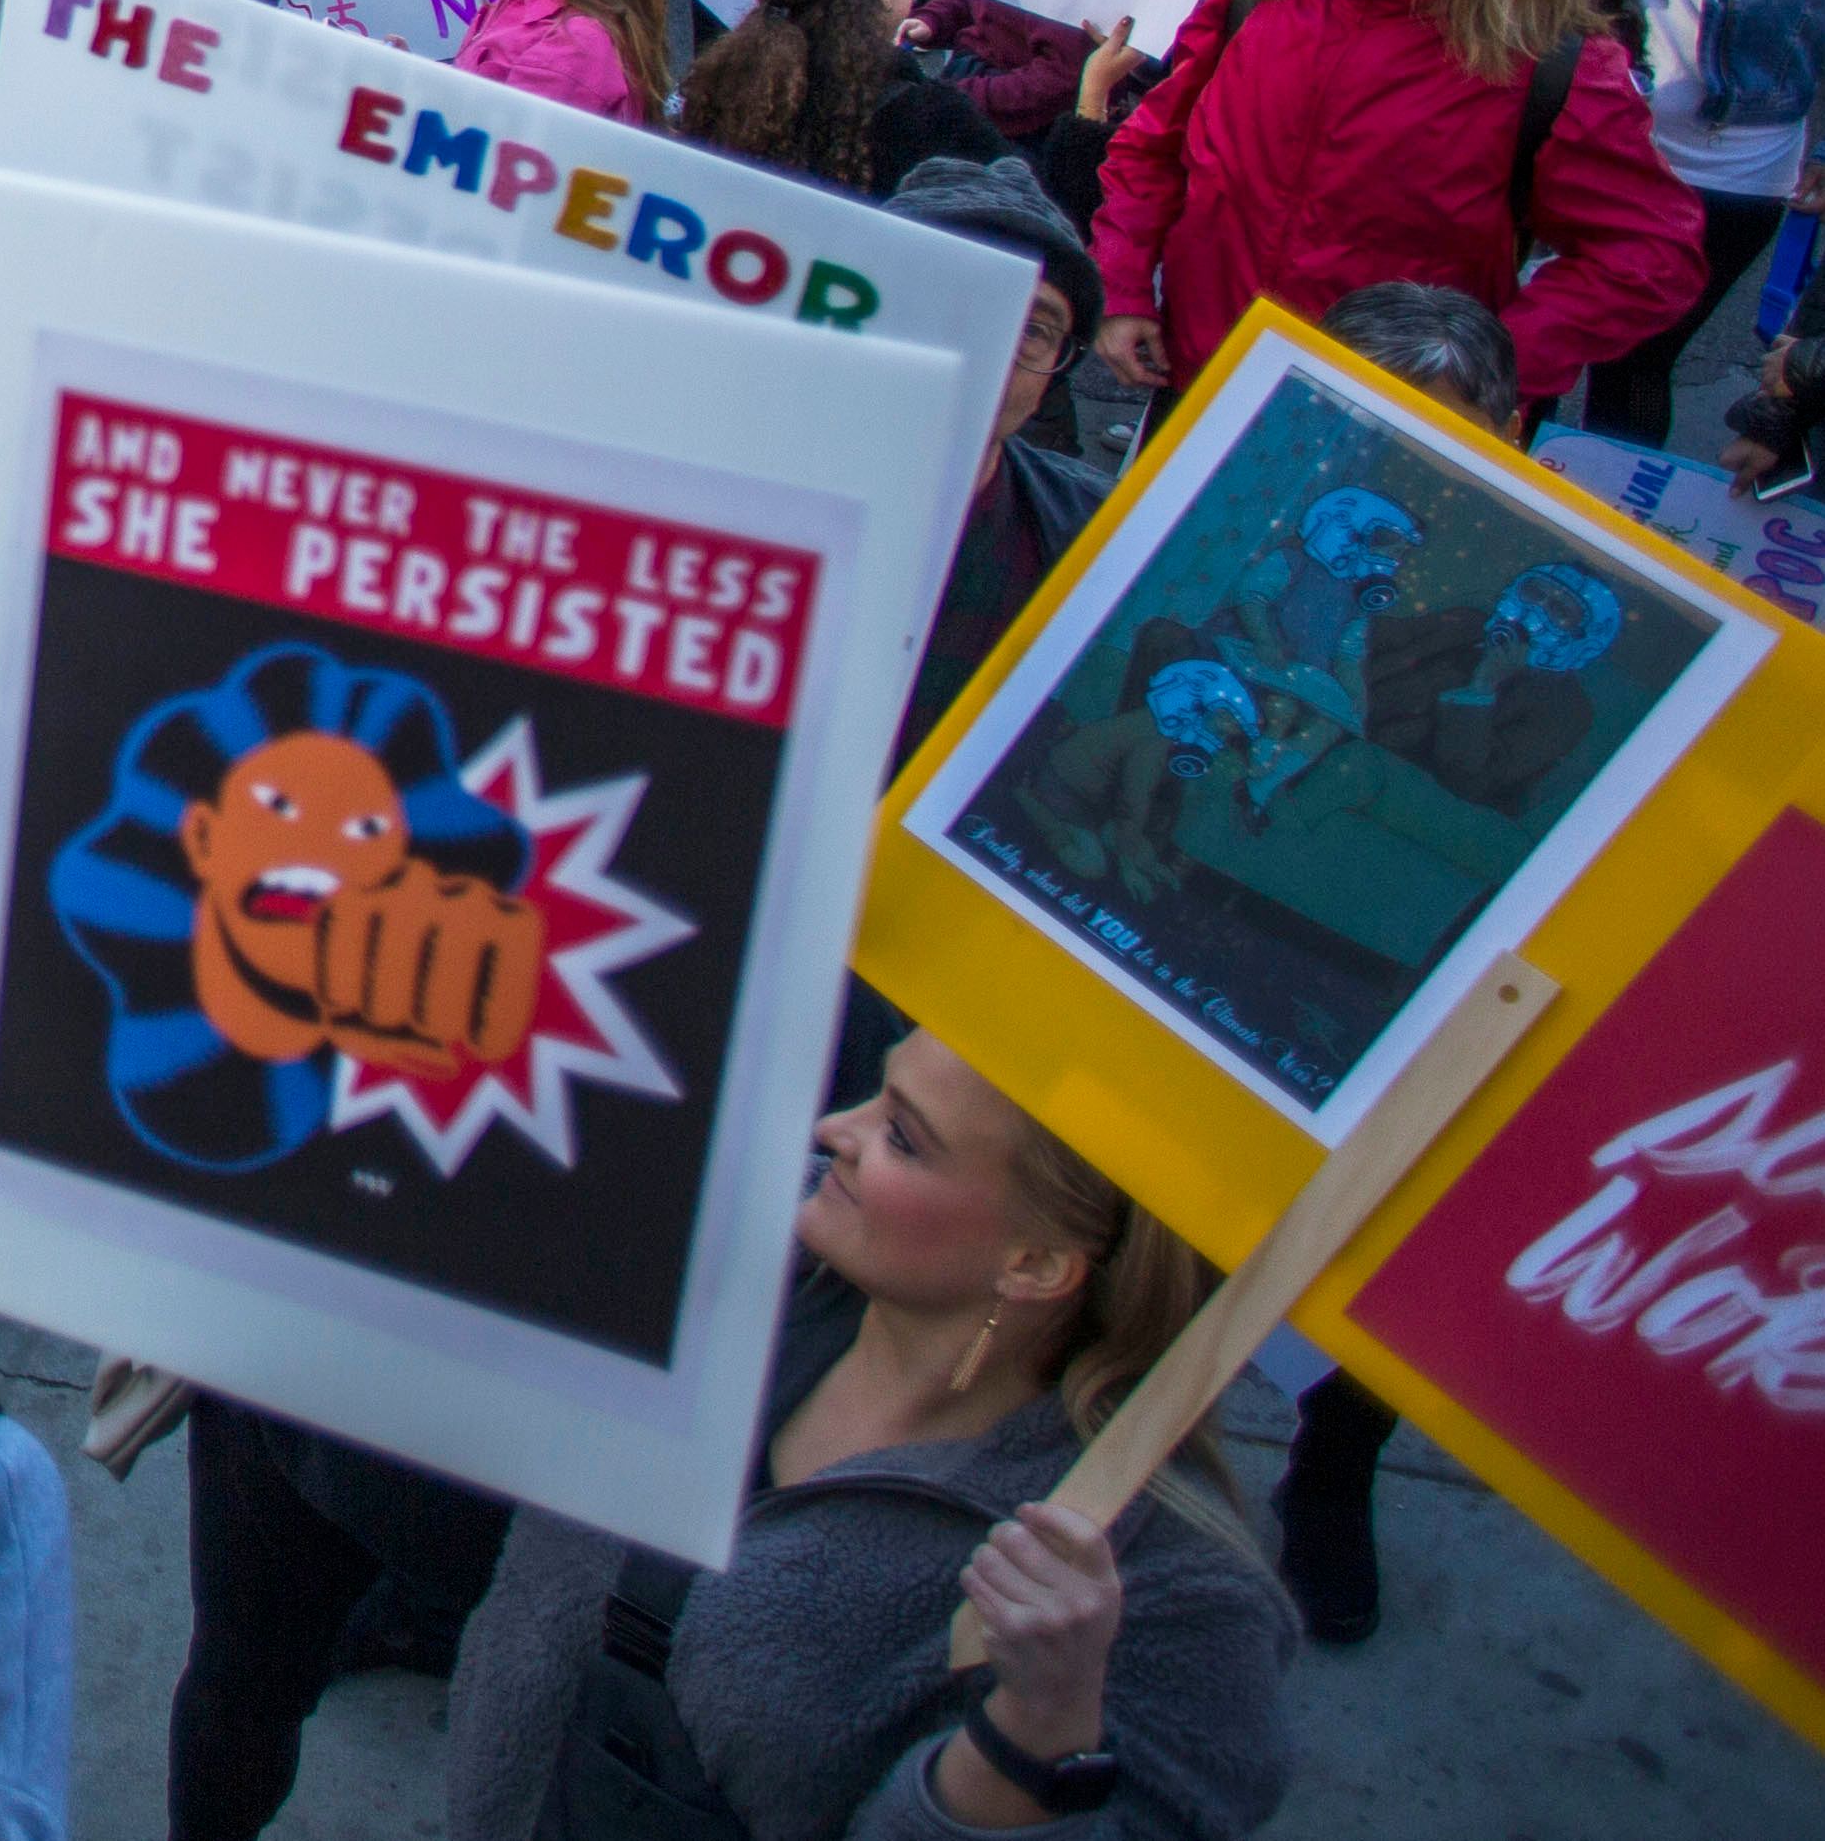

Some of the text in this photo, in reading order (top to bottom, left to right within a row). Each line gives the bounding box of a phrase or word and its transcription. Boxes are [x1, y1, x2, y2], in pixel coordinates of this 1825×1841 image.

[338, 87, 882, 334] EMPEROR
[68, 410, 798, 616] AND NEVER THE LESS
[68, 473, 786, 708] SHE PERSISTED
[1084, 906, 1139, 954] YOU
